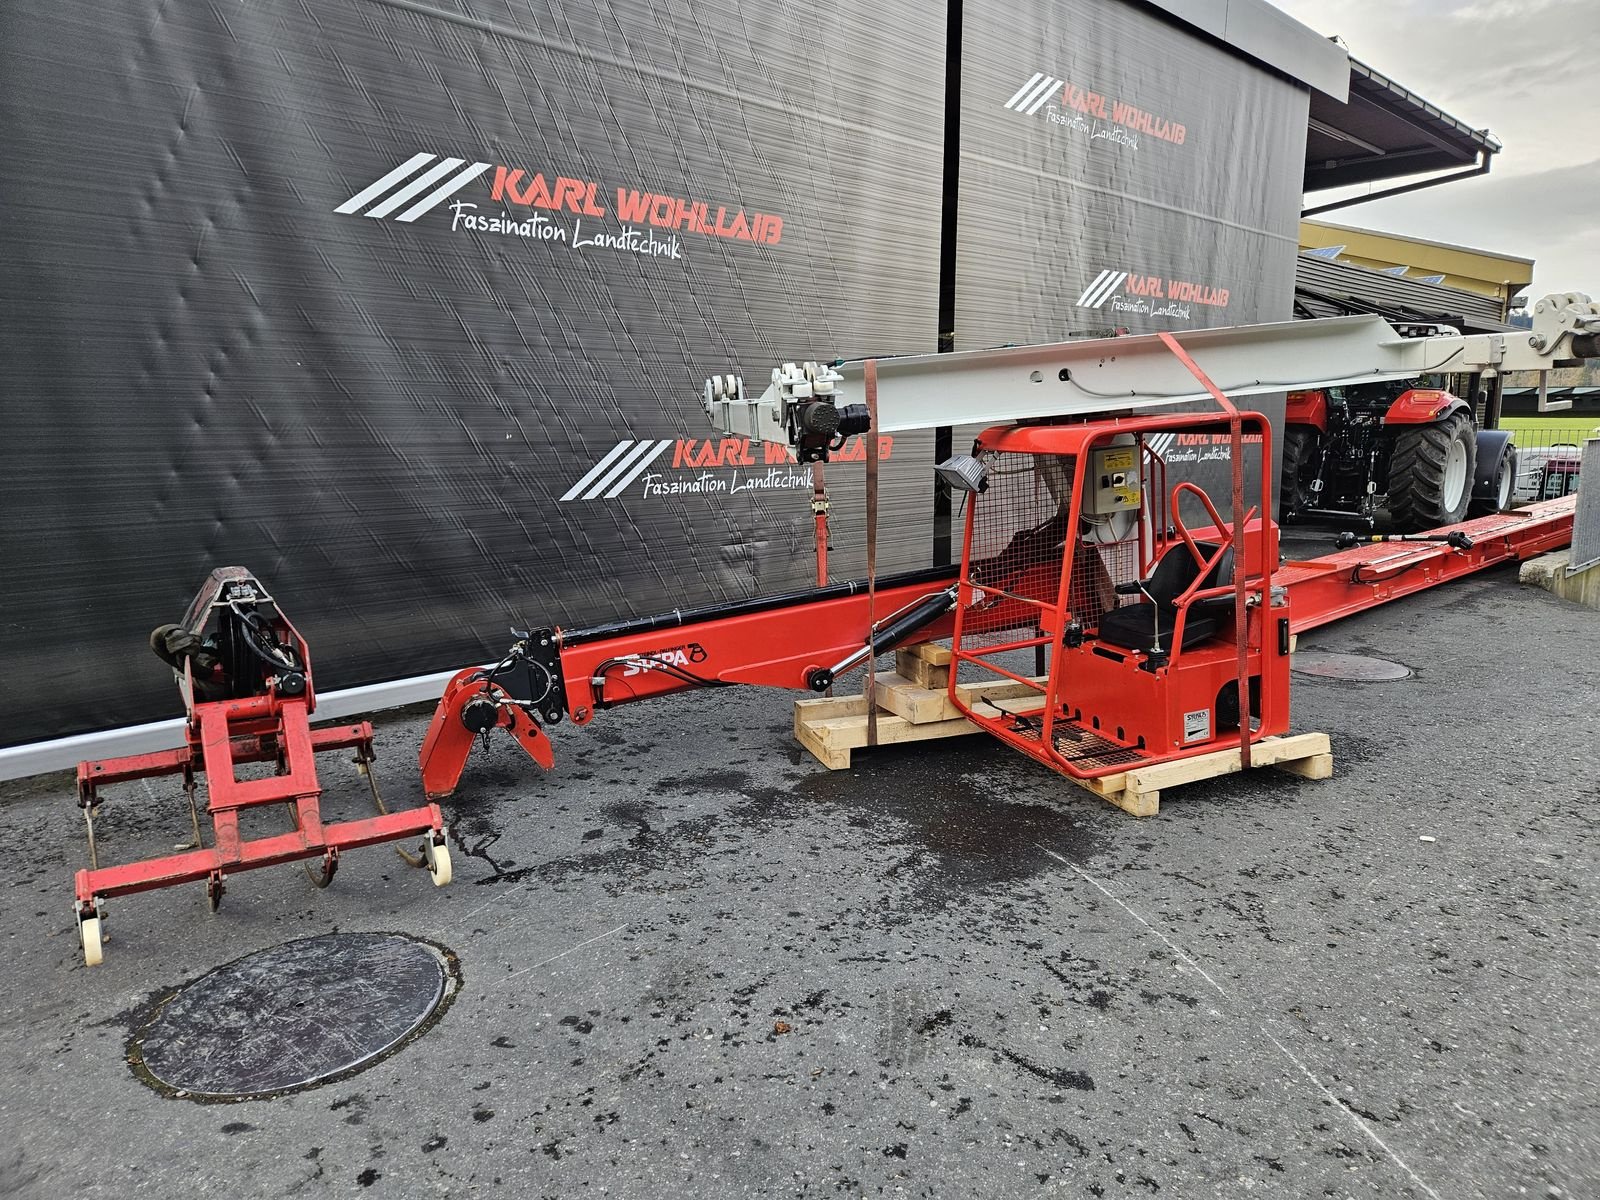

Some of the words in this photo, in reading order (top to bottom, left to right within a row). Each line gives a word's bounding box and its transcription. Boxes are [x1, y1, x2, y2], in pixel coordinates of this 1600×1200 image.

[1062, 82, 1107, 119] KARL
[1046, 105, 1089, 133] Faszination
[1091, 119, 1139, 150] Landtechnik
[491, 166, 605, 217] KARL
[449, 200, 566, 241] Faszination
[572, 218, 682, 260] Landtechnik
[1125, 274, 1164, 298] KARL
[1111, 295, 1149, 313] Faszination
[1150, 300, 1191, 320] Landtechnik
[672, 438, 755, 468] KARL
[1165, 448, 1197, 464] Faszination
[1198, 446, 1231, 464] Landtechnik
[642, 472, 726, 498] Faszination
[730, 467, 814, 495] Landtechnik
